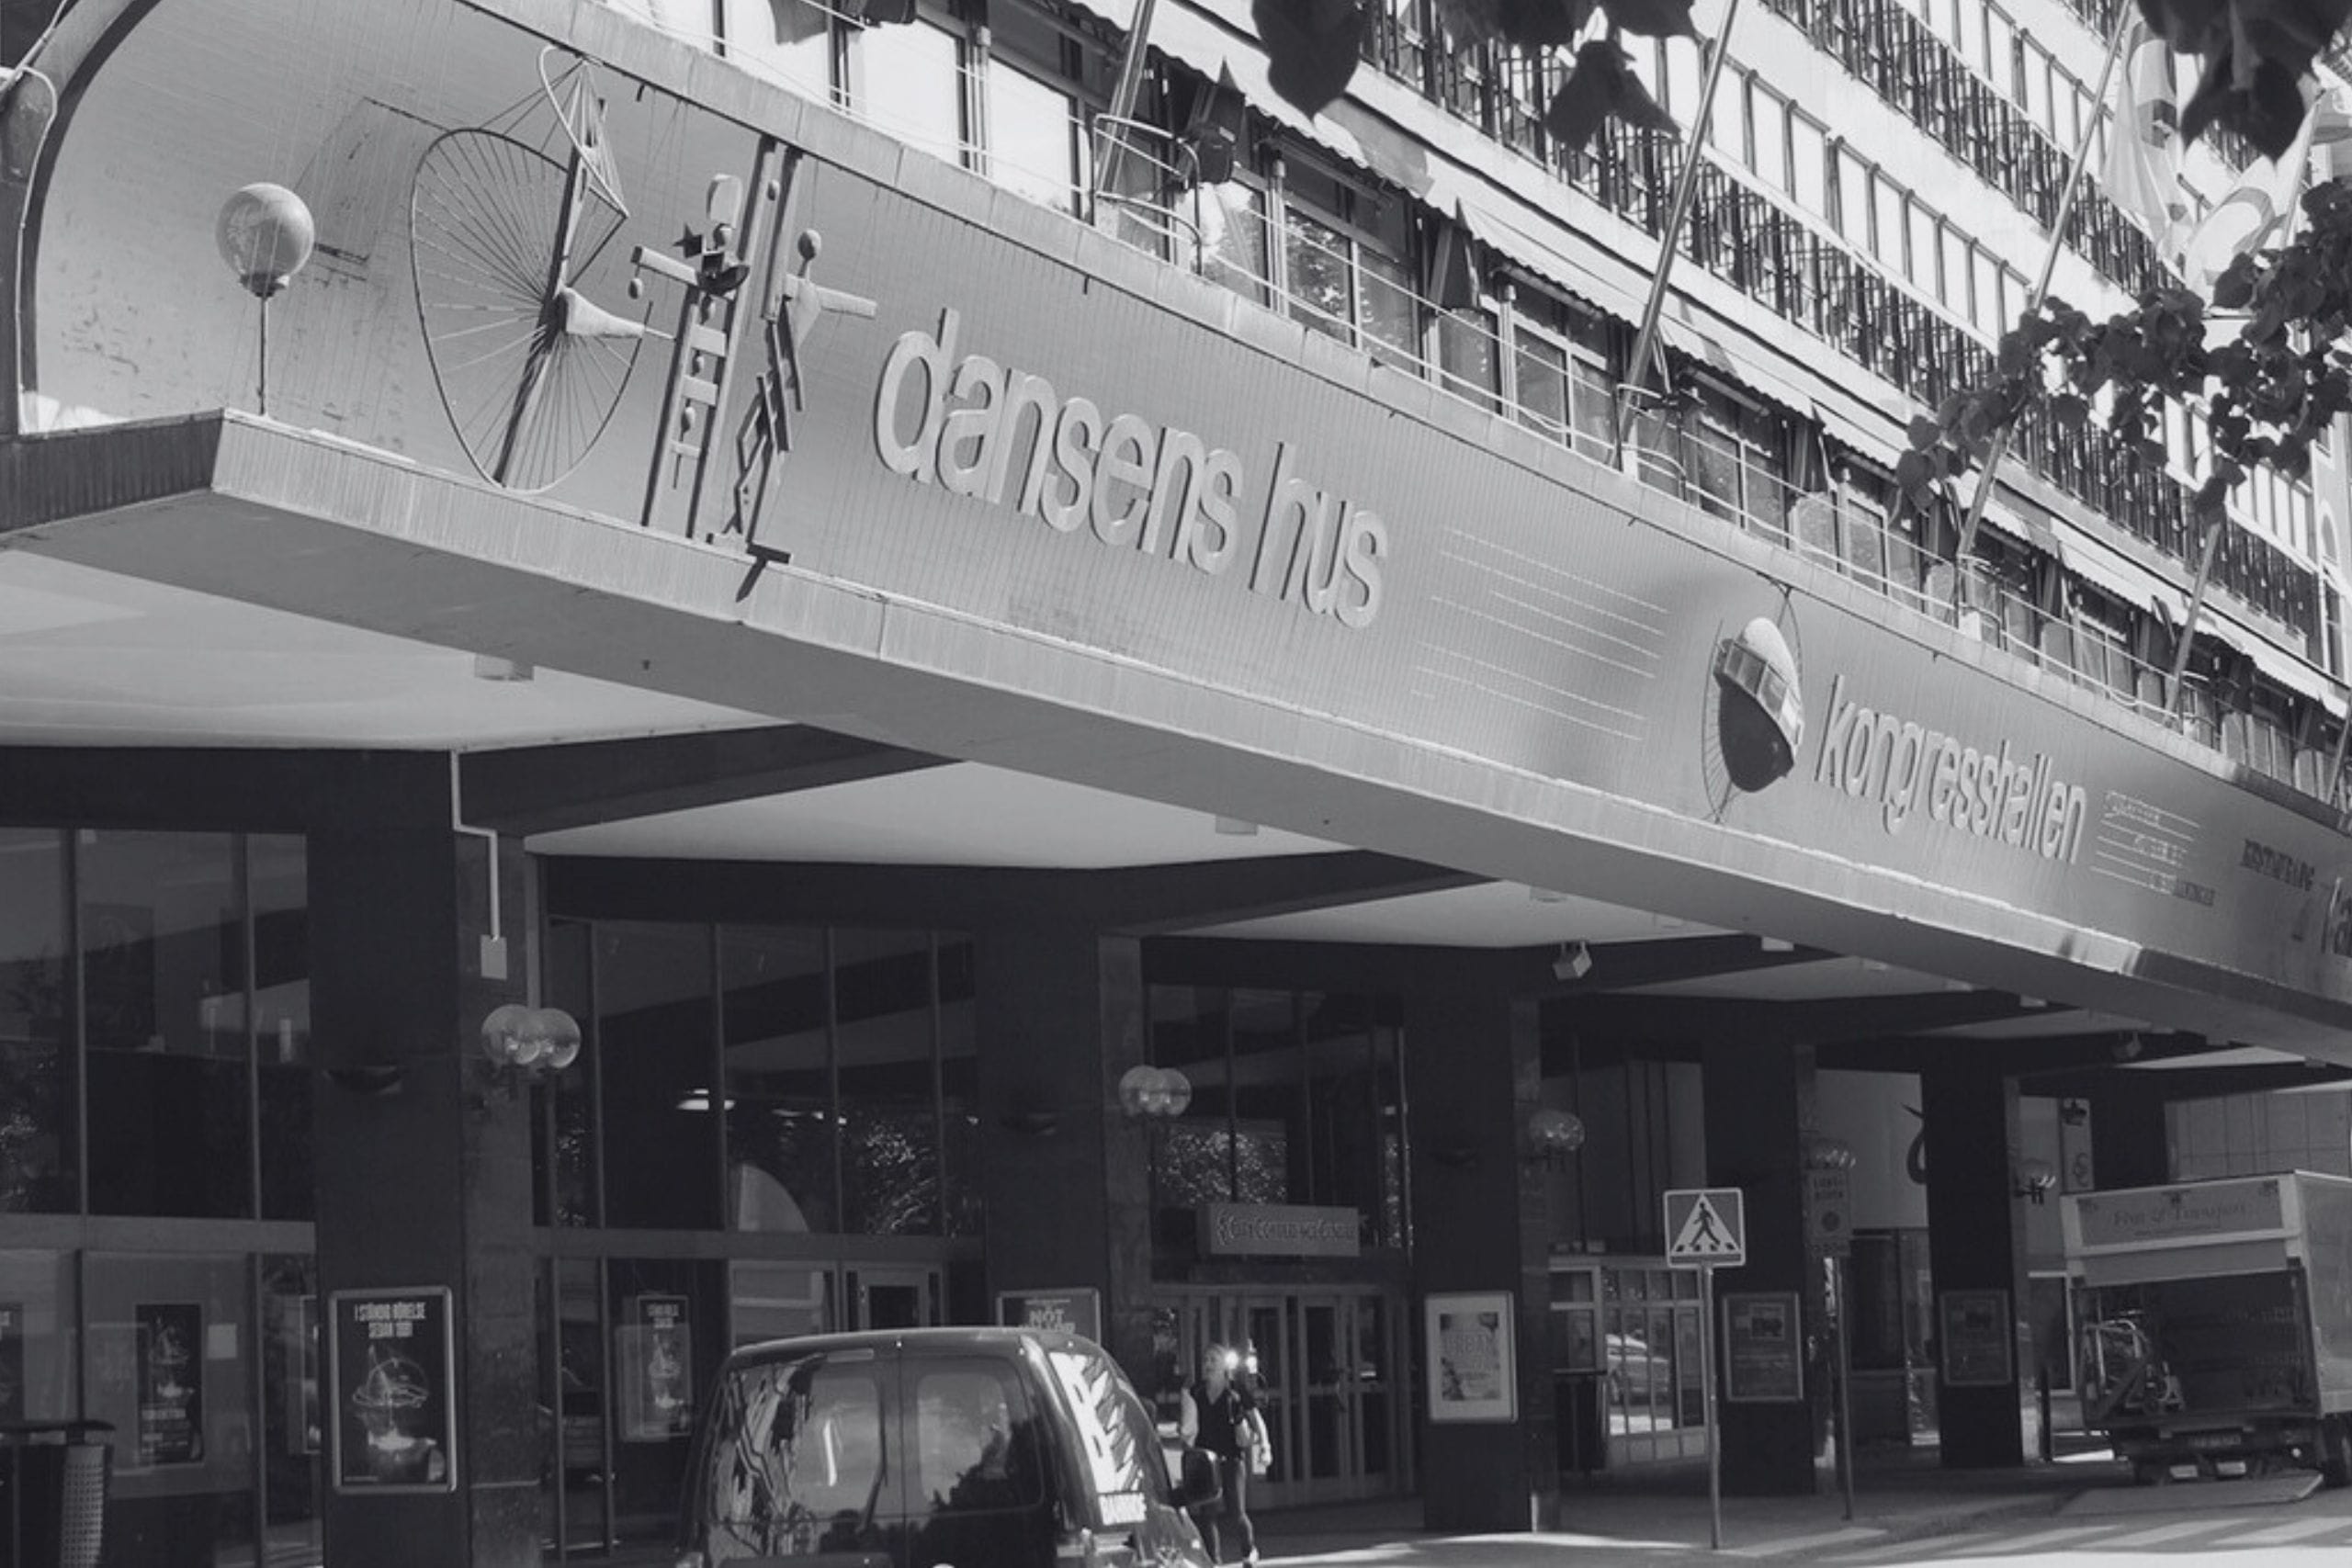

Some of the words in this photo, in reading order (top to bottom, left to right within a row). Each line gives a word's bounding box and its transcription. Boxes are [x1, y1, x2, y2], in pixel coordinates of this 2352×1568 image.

[874, 307, 1243, 575] dansens
[1249, 441, 1388, 628] hus
[1815, 674, 2087, 865] kongresshallen
[1029, 1309, 1065, 1330] NOT
